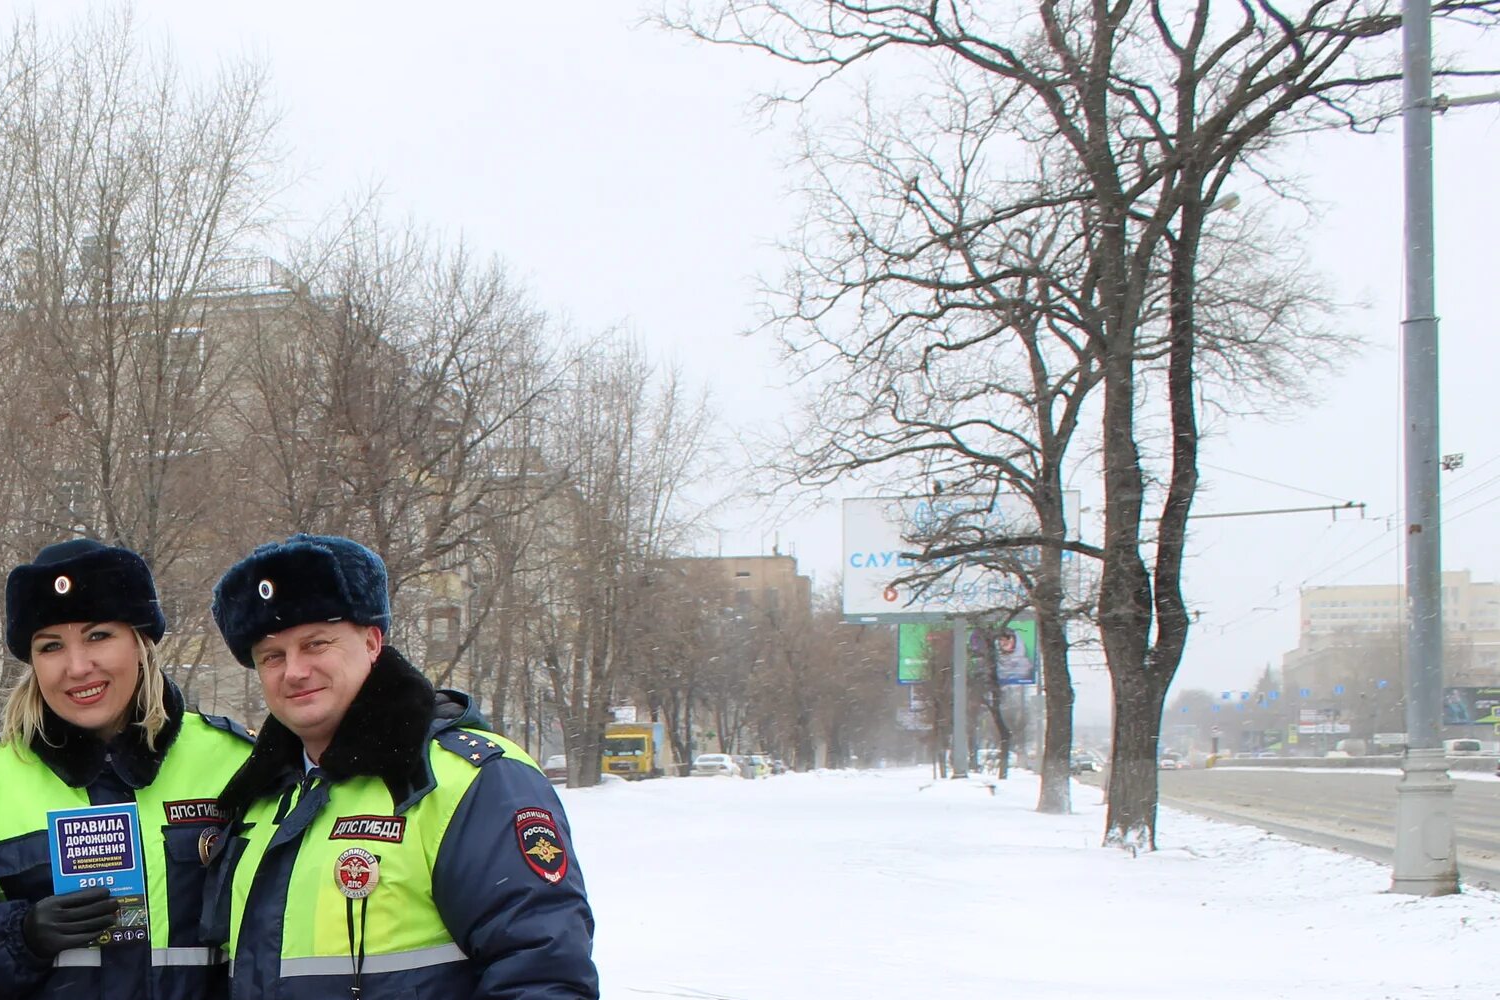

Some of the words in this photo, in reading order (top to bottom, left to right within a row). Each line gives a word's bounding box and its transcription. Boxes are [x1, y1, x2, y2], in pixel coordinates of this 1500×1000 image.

[170, 804, 196, 820] ДПС
[517, 811, 551, 822] ПОЛИЦИЯ
[64, 818, 125, 835] ПРАВИЛА
[334, 820, 359, 836] ДПС
[358, 820, 401, 839] ГИБДД
[523, 826, 556, 840] РОССИЯ
[65, 832, 126, 847] ДОРОЖНОГО
[66, 843, 126, 859] ДВИЖЕНИЯ
[339, 848, 376, 864] ПОЛИЦИЯ
[79, 876, 114, 888] 2019
[346, 880, 362, 889] ДПС
